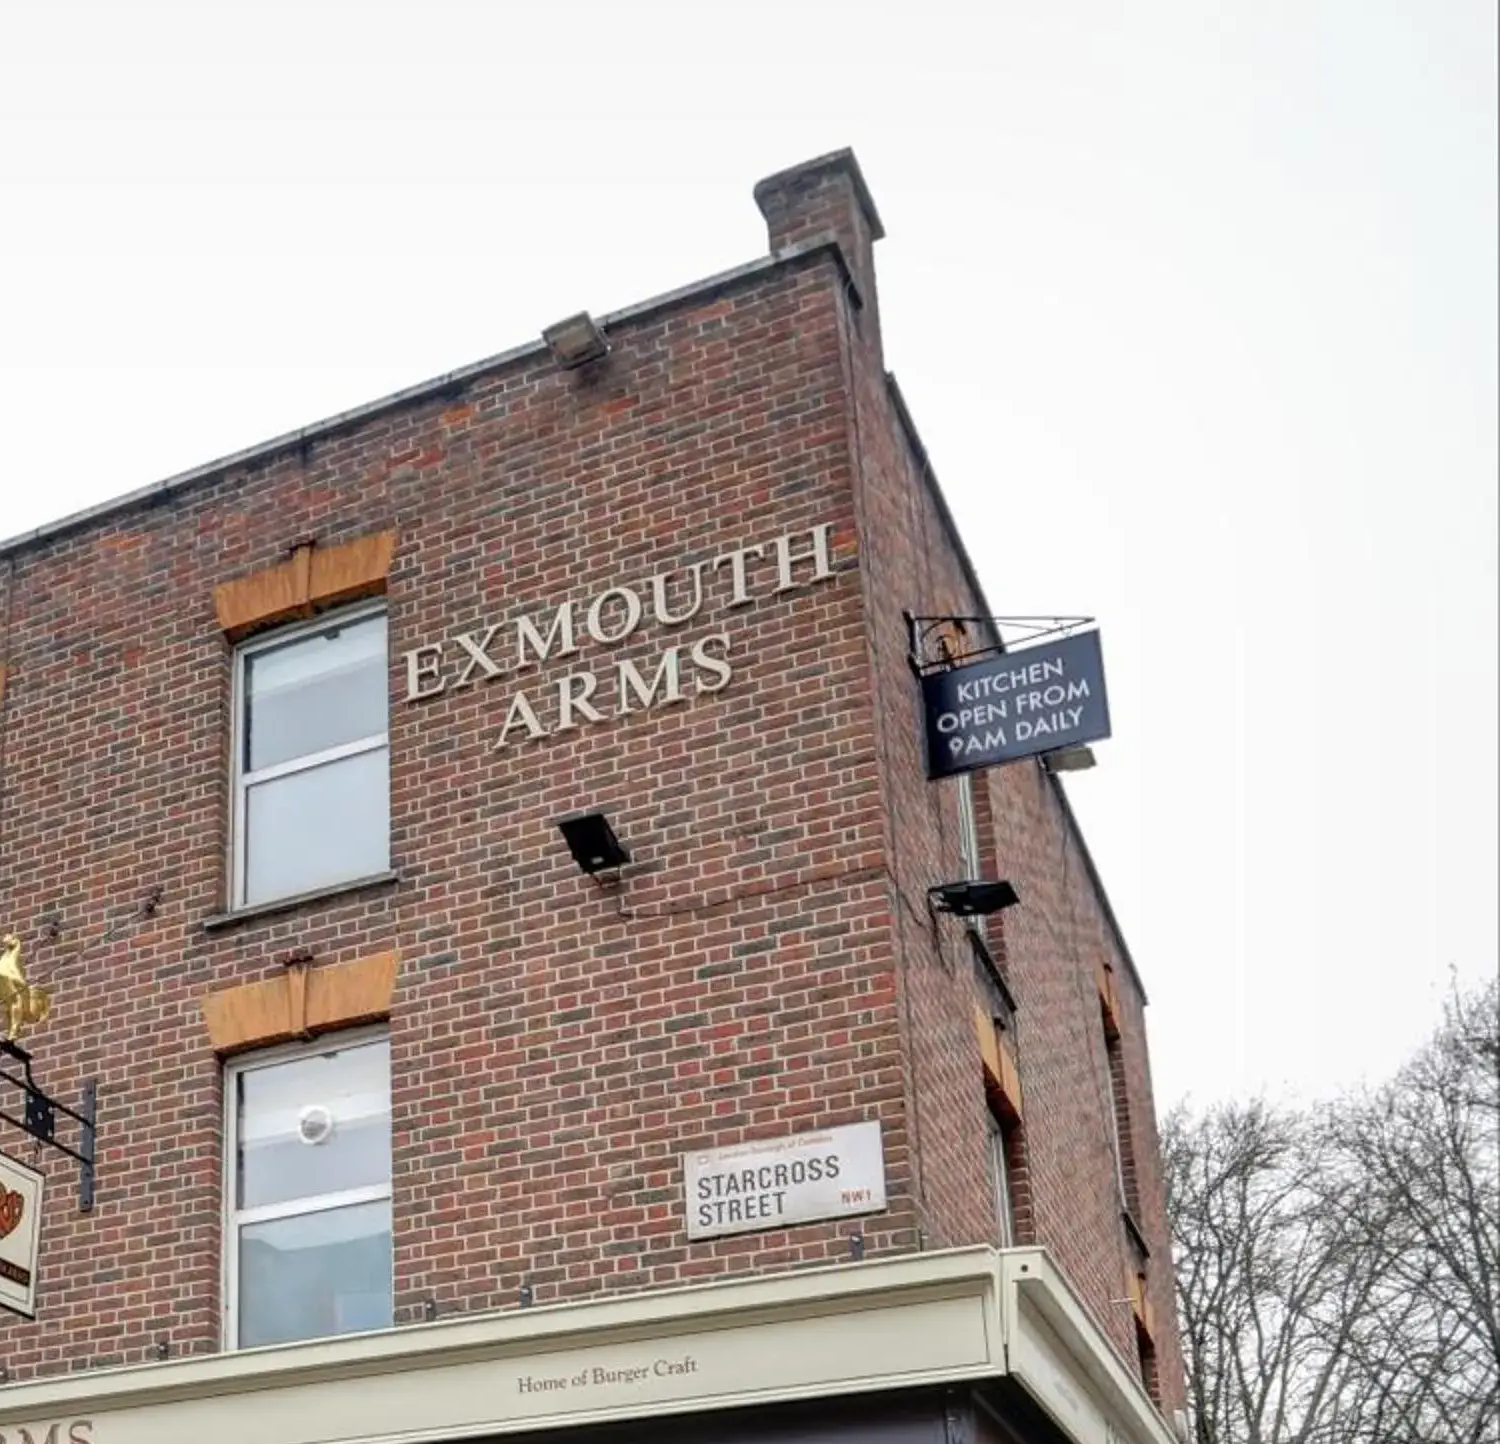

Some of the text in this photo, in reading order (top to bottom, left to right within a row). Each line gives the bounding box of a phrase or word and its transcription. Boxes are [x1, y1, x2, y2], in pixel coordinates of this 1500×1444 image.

[402, 521, 838, 703] EXMOUTH
[494, 631, 733, 749] ARMS
[936, 677, 1091, 733] OPEN FROM
[956, 657, 1064, 704] KITCHEN
[949, 705, 1084, 757] 9AM DAILY
[697, 1154, 841, 1200] STARCROSS
[698, 1188, 872, 1227] STREET NW1
[516, 1355, 700, 1394] Home of Burger Craft
